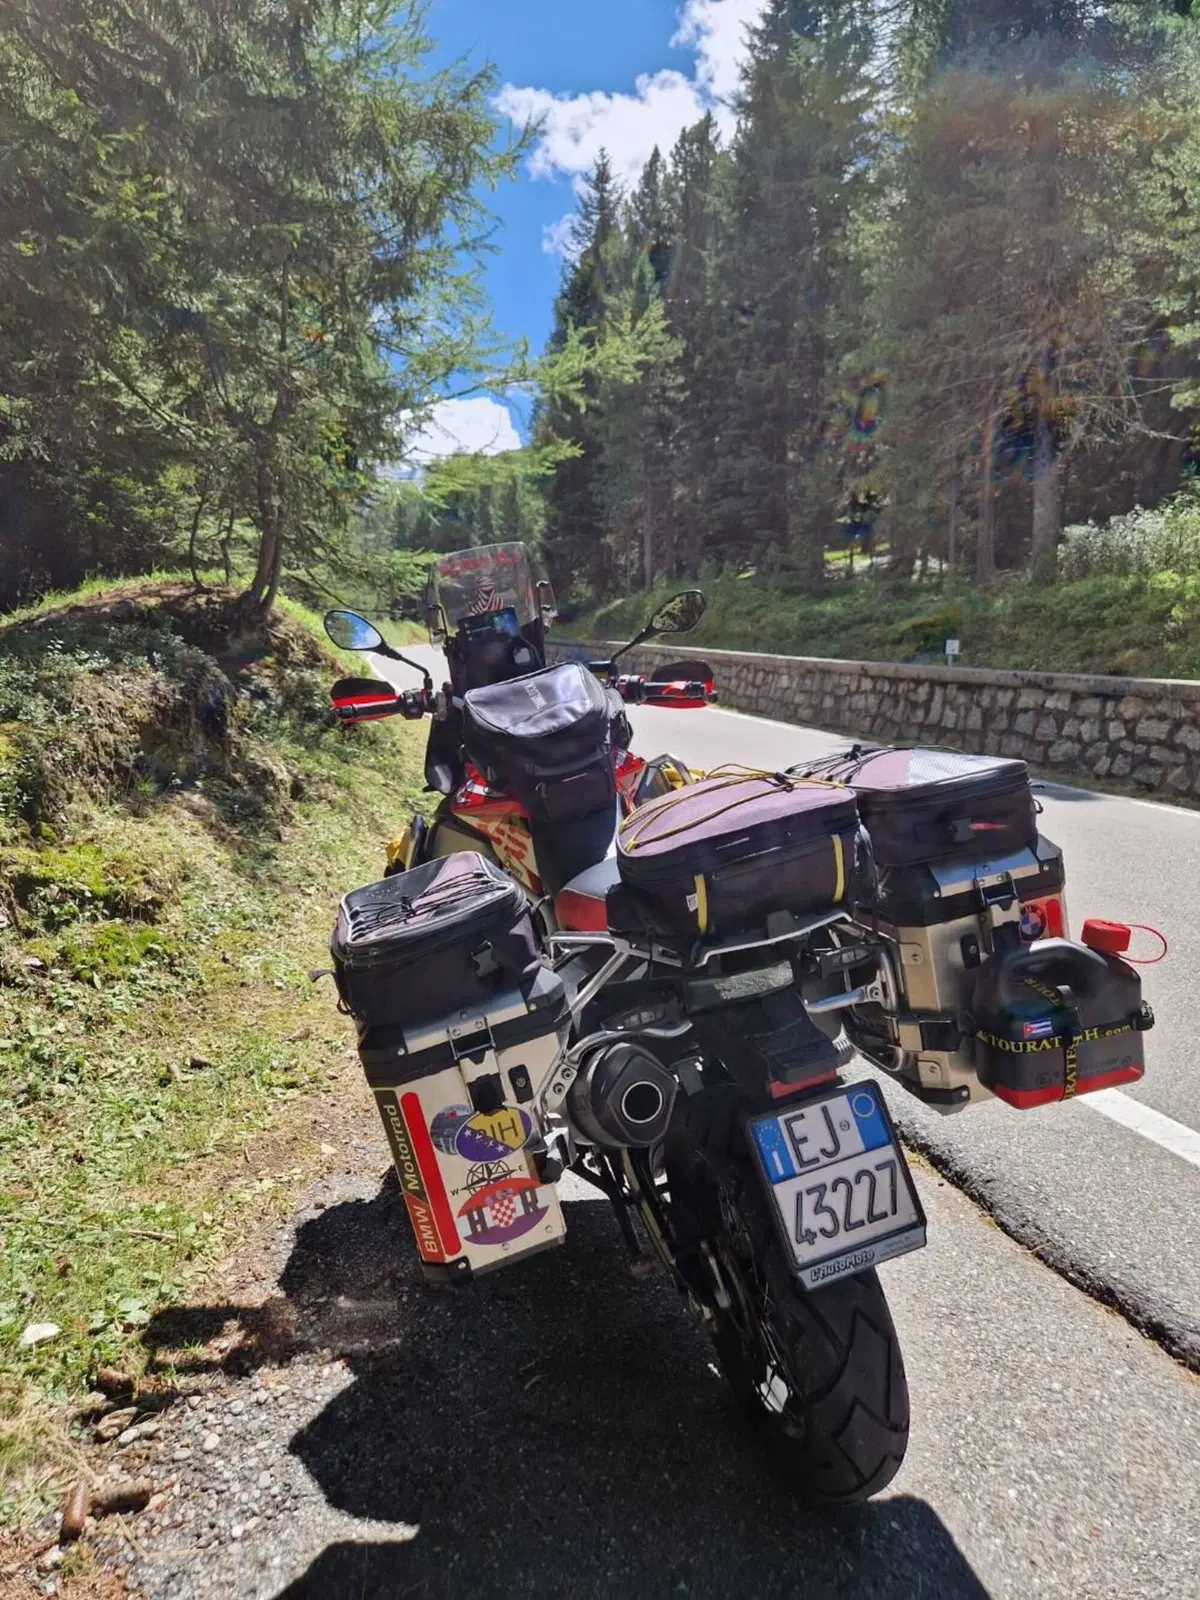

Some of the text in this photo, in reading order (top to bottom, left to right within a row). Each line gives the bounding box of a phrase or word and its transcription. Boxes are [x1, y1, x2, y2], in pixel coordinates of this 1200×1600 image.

[772, 1151, 784, 1175] I
[784, 1105, 841, 1168] EJ
[383, 1104, 439, 1253] BMW Motorrad
[795, 1159, 898, 1246] 43227
